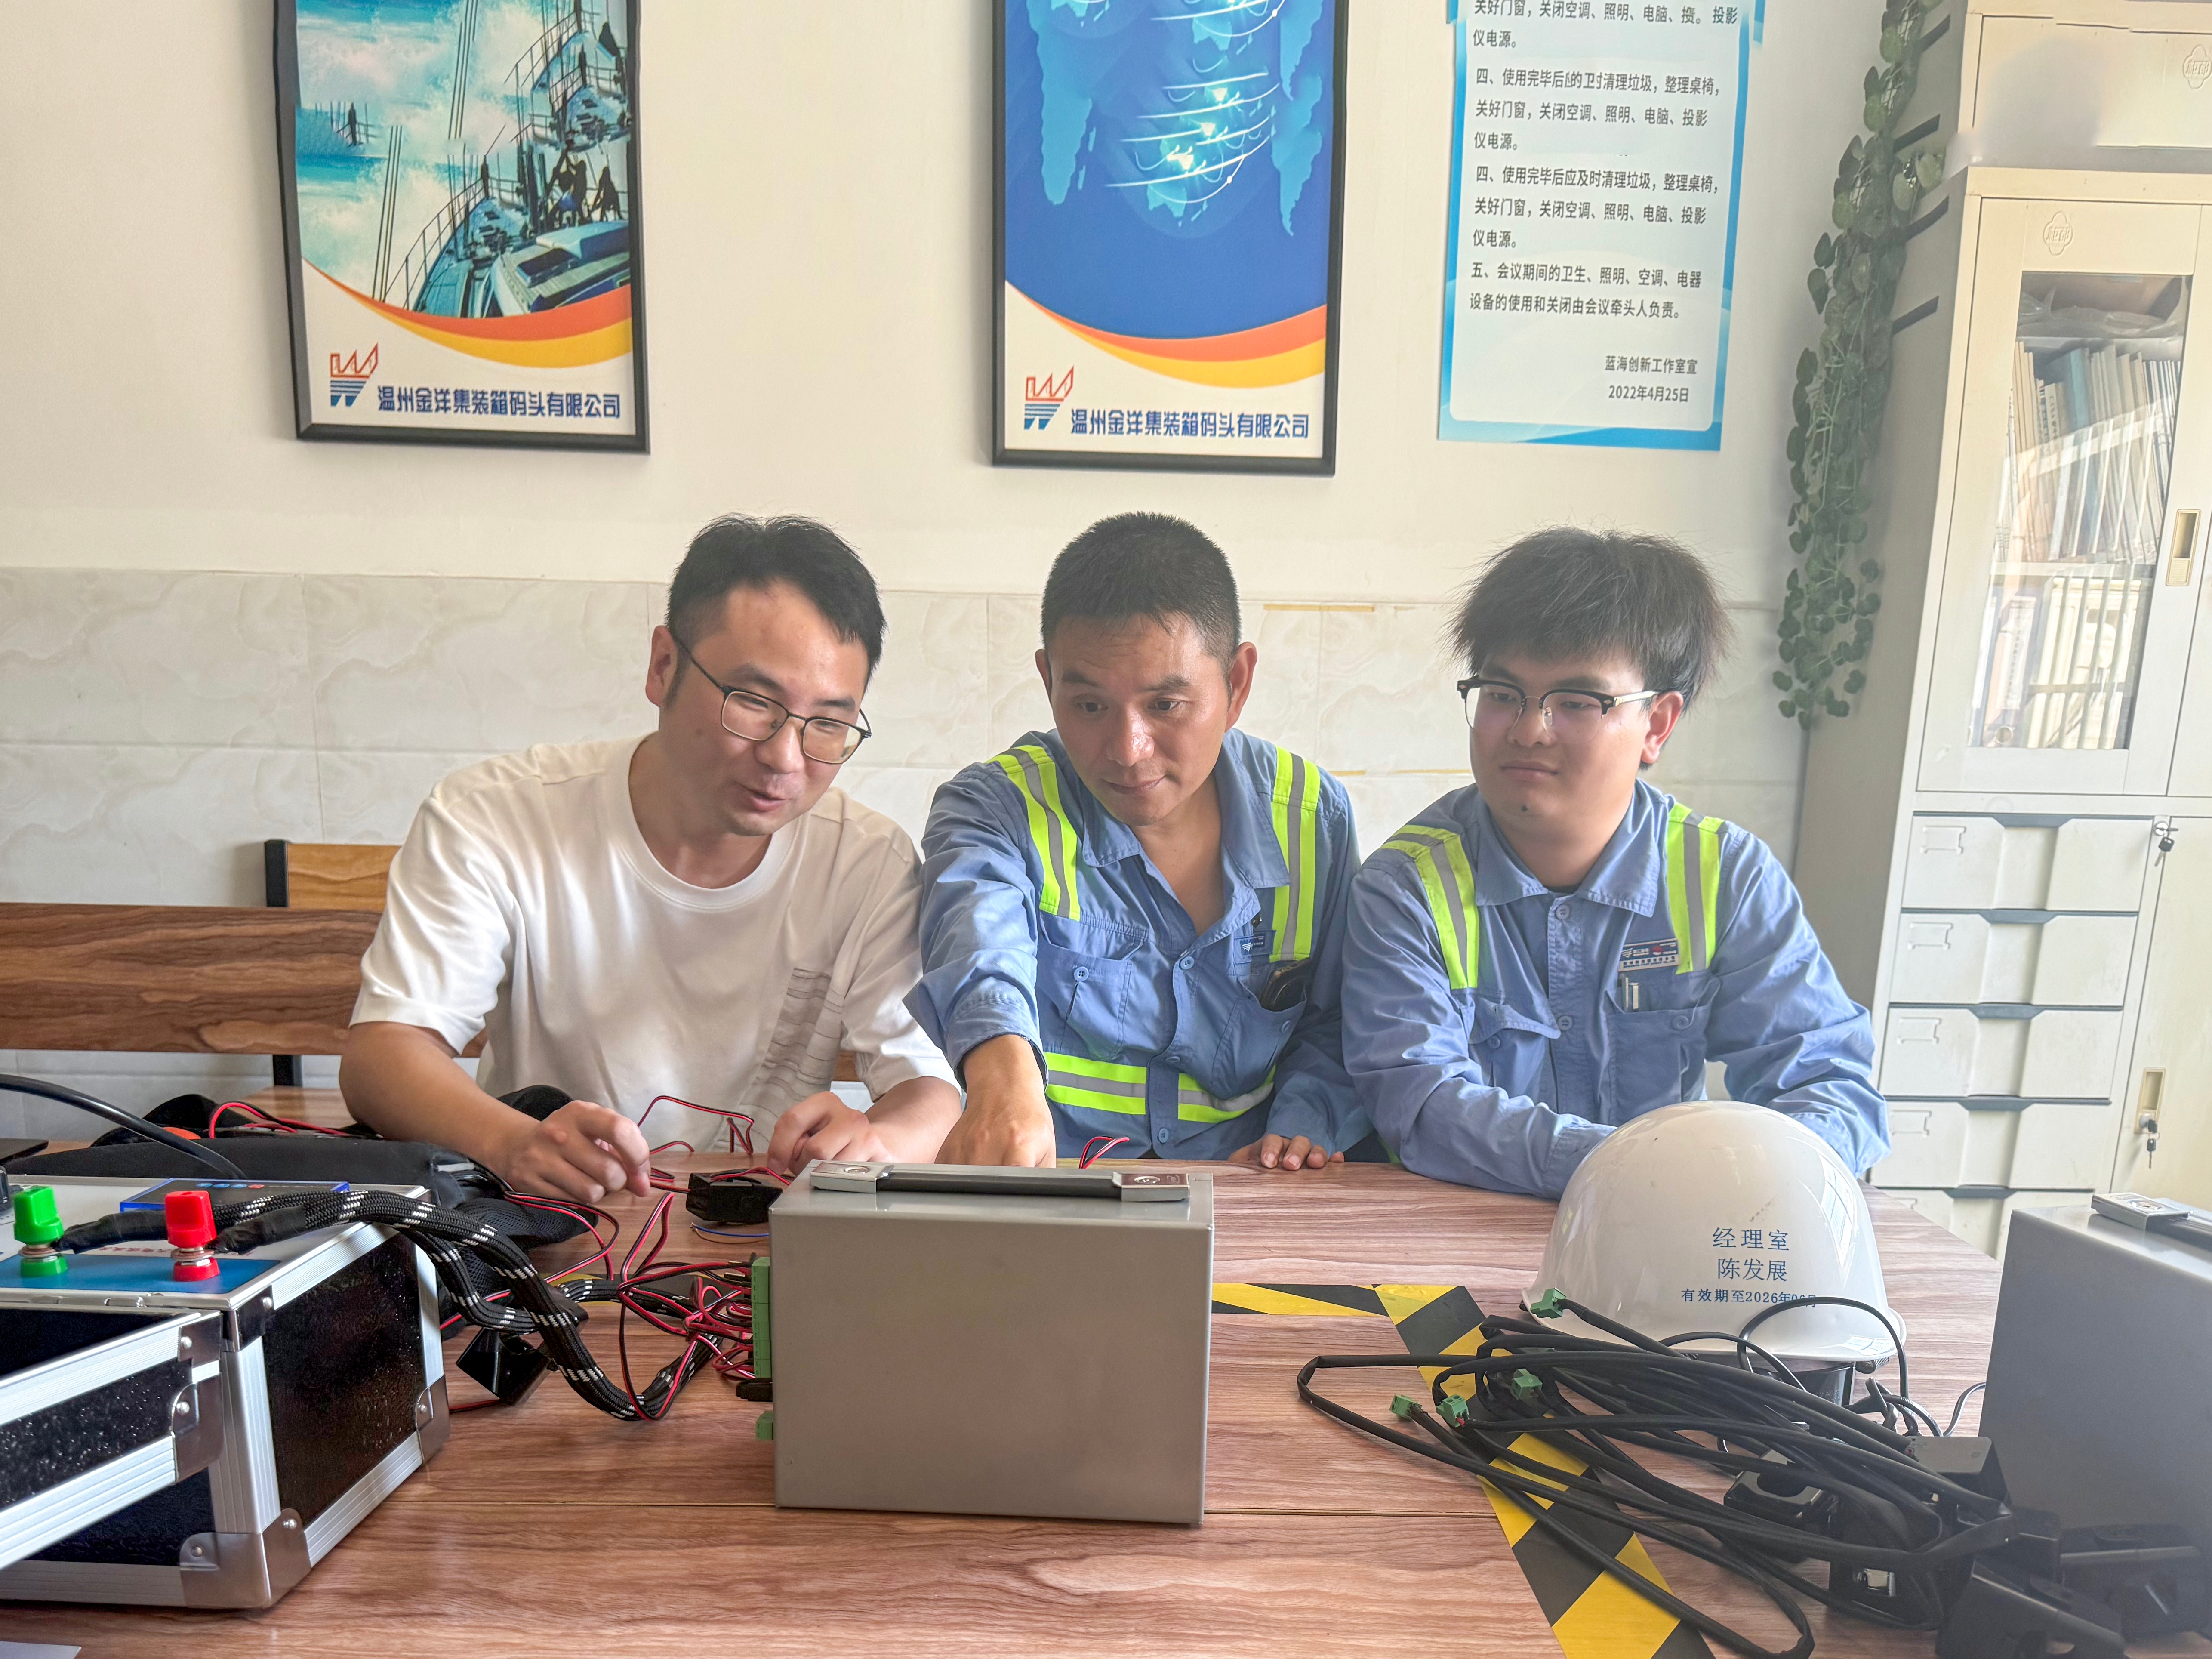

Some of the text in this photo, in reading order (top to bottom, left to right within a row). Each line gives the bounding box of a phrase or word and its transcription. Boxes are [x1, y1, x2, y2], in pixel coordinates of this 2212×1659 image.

[1473, 29, 1516, 48] 仪电源。
[1476, 99, 1708, 127] 关好门窗，关闭空调、照明、电脑、投影
[1474, 131, 1518, 151] 仪电源。
[1474, 197, 1707, 225] 关好门窗，关闭空调、照明、电脑、投影
[1473, 229, 1516, 248] 仪电源。
[1471, 262, 1702, 288] 五、会议期间的卫生、照明、空调、电器
[1470, 293, 1679, 319] 设备的使用和关闭由会议牵头人负责。
[377, 385, 621, 419] 温州金洋集装箱码头有限公司
[1608, 385, 1689, 403] 2022年4月25日
[1070, 408, 1309, 439] 温州金洋集装箱码头有限公司
[1712, 1227, 1790, 1251] 经理室
[1718, 1258, 1788, 1282] 陈发展
